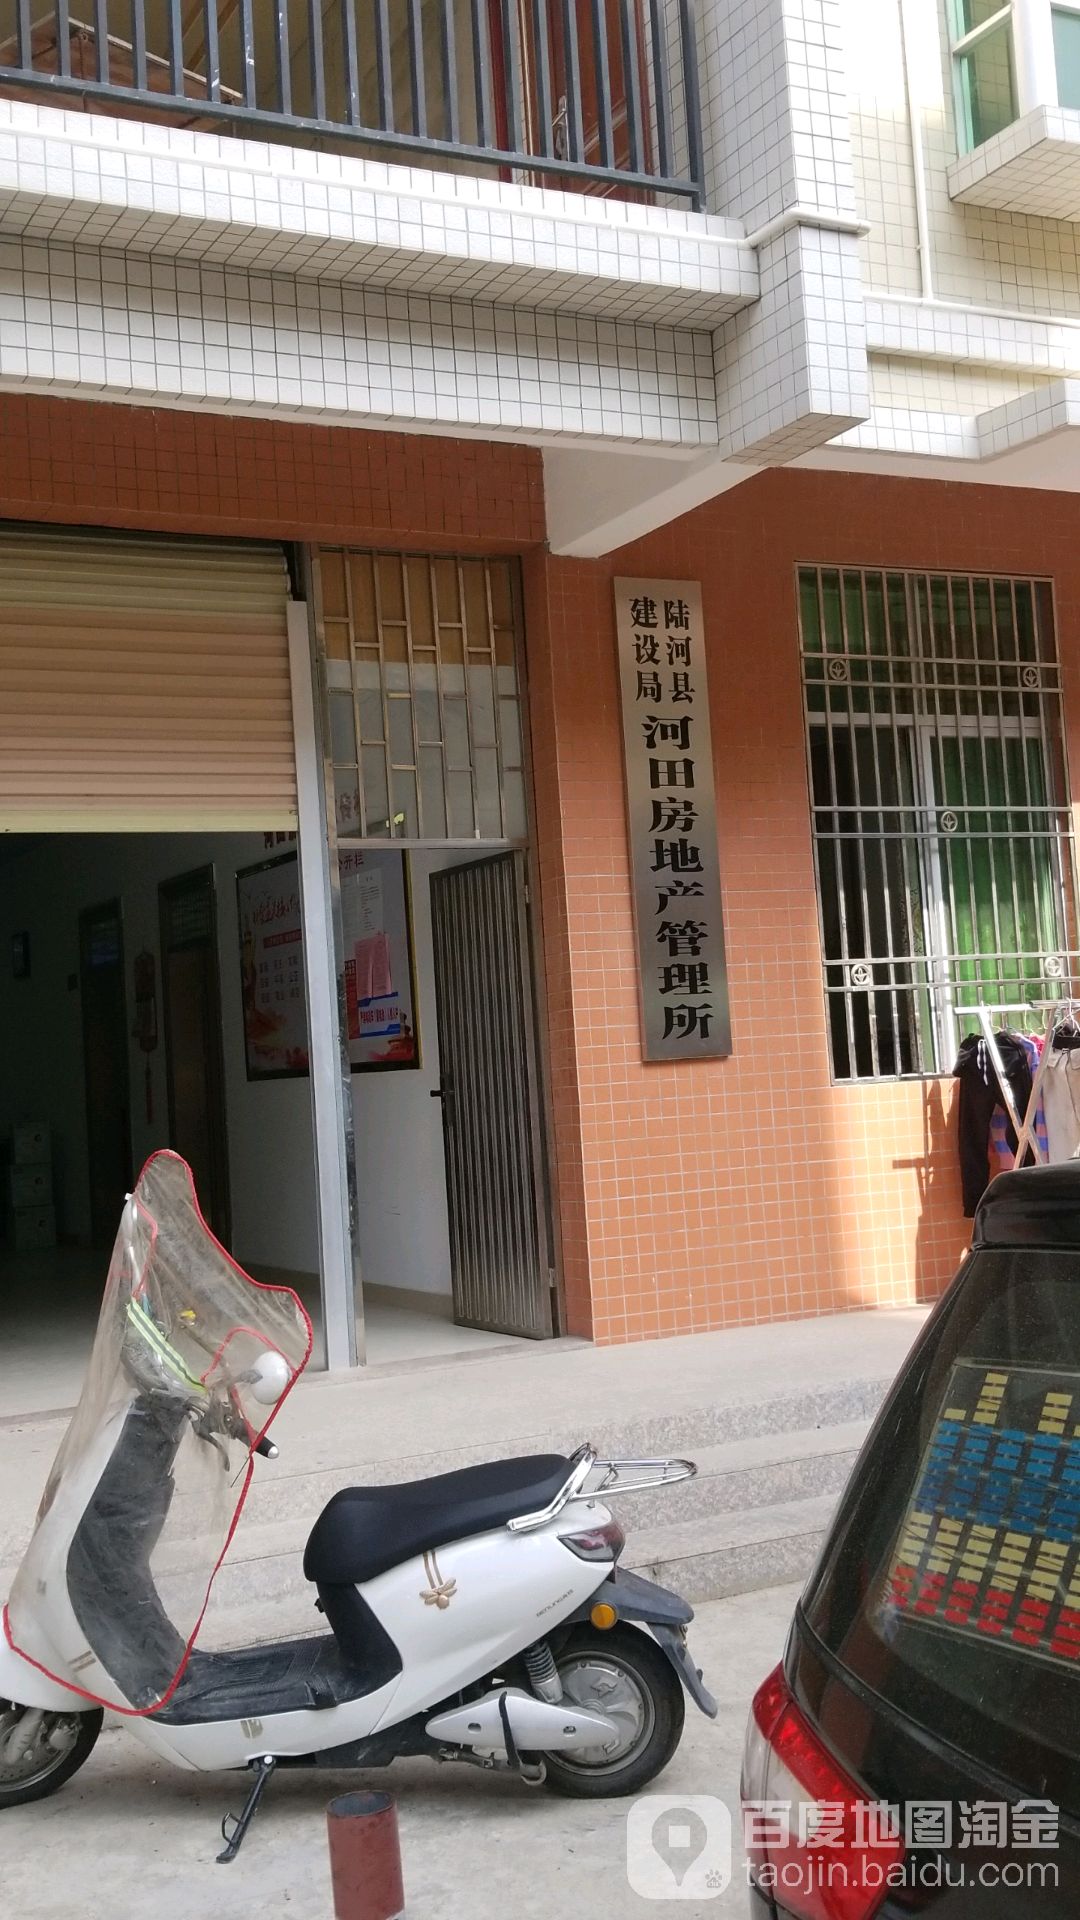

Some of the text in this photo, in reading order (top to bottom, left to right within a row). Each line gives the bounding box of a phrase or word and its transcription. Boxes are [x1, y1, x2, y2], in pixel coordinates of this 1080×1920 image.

[628, 596, 662, 703] 建设局
[663, 599, 696, 704] 陆河县
[641, 715, 714, 1040] 河田房地产管理所
